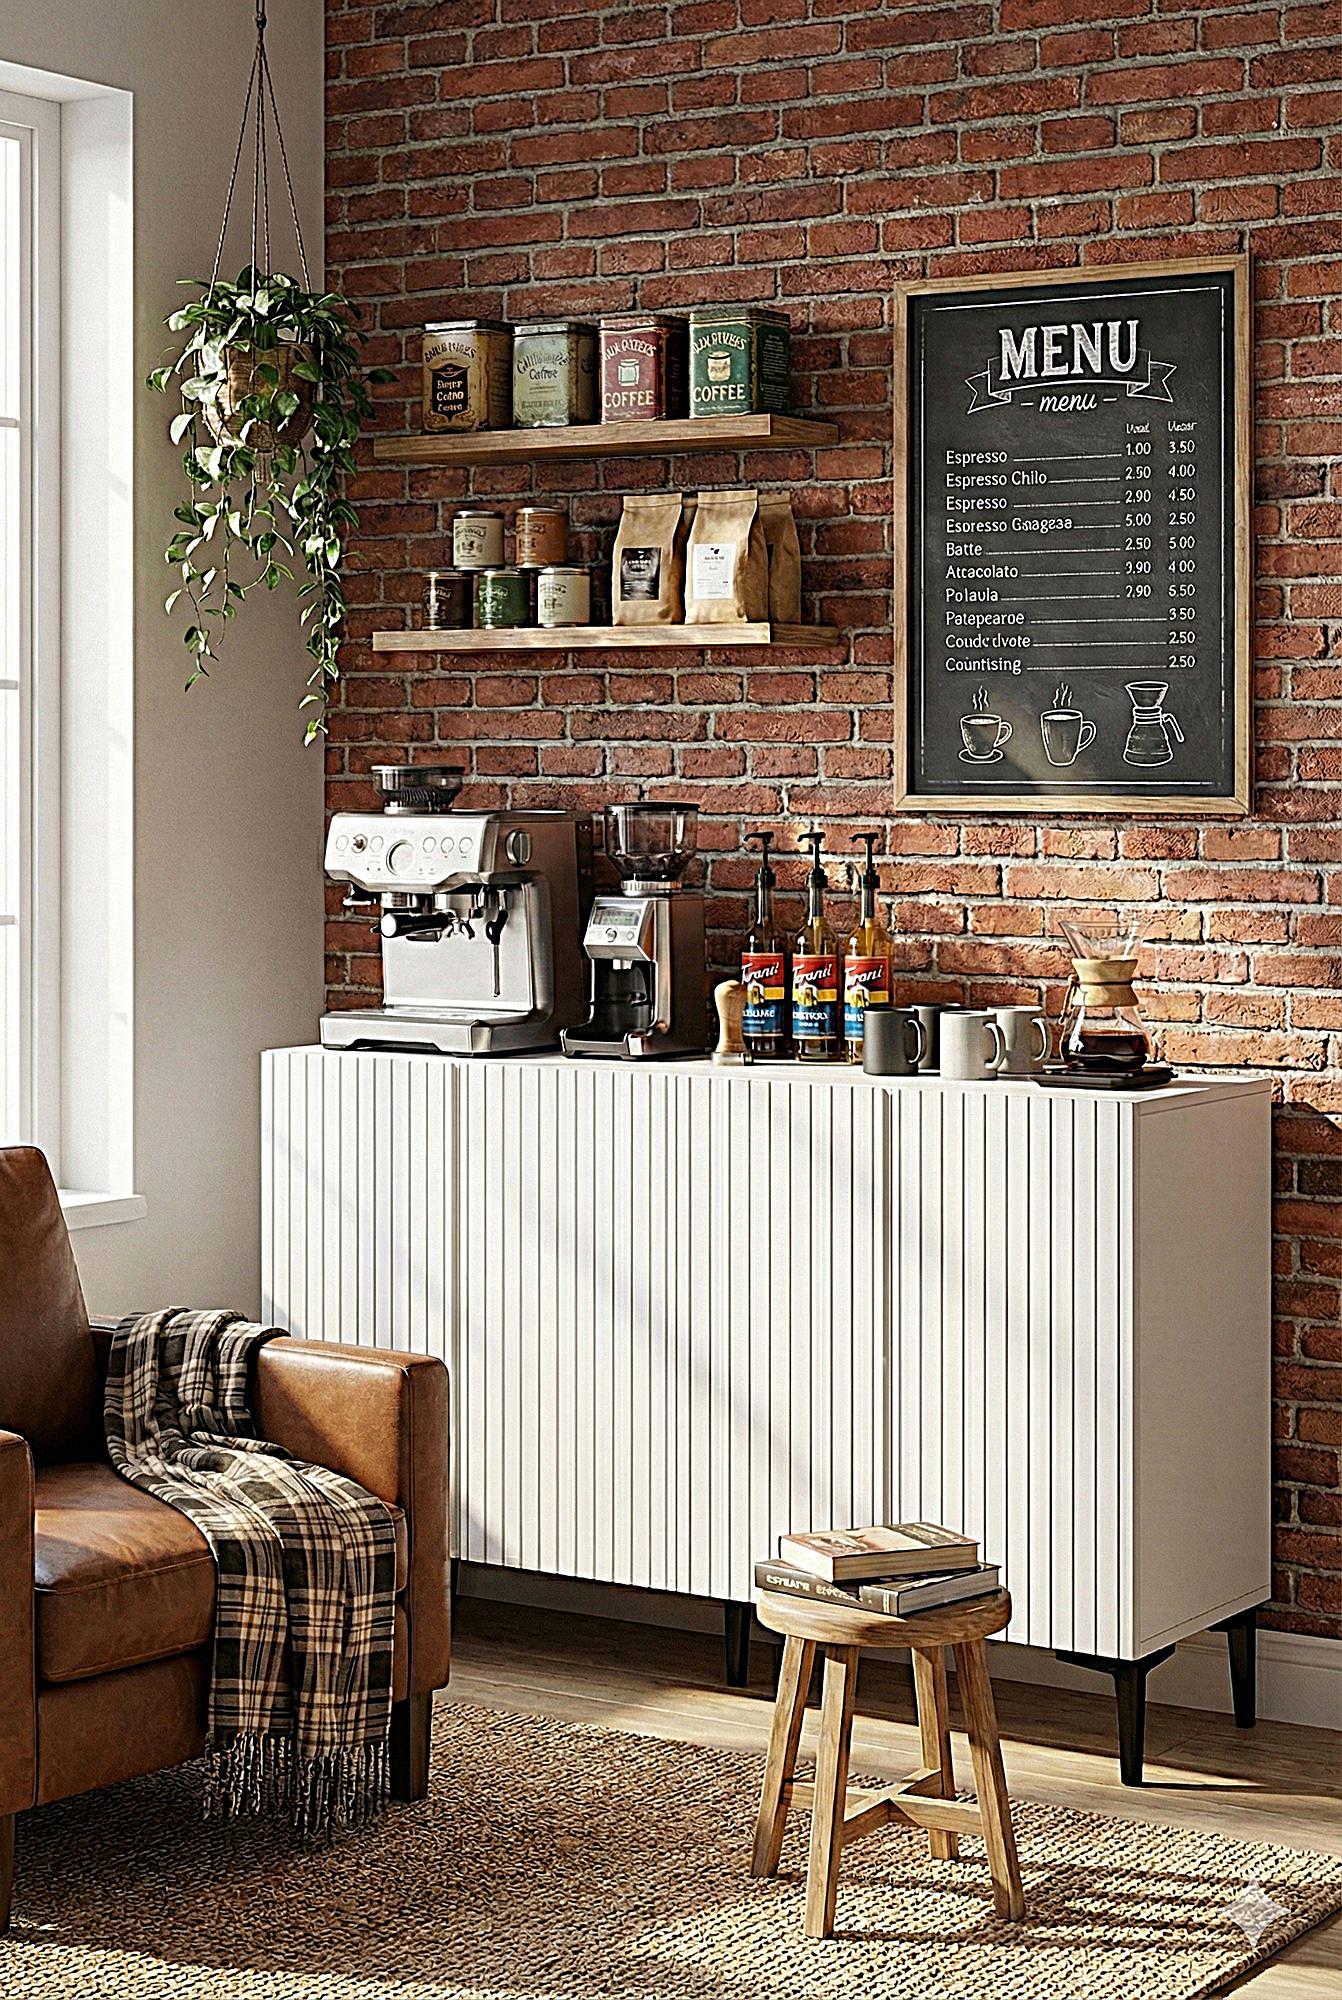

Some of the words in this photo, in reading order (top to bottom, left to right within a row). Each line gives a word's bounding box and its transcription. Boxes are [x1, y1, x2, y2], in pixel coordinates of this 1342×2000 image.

[999, 319, 1139, 381] MENU
[605, 390, 655, 408] COFFEE
[693, 384, 745, 402] COFFEE
[1039, 393, 1097, 412] menu
[946, 450, 1008, 467] Espresso
[1125, 442, 1151, 456] 1.00
[1168, 440, 1195, 454] 3.50
[946, 473, 1007, 490] Espresso
[1011, 470, 1047, 485] Chilo
[1168, 464, 1195, 478] 4.00
[946, 496, 1007, 513] Espresso
[1125, 489, 1151, 504] 2.90
[1168, 488, 1195, 502] 4.50
[1125, 513, 1151, 527] 5.00
[1168, 512, 1195, 526] 2.50
[946, 542, 983, 556] Batte
[1125, 537, 1151, 551] 2.50
[1168, 631, 1195, 645] 2.50
[1168, 655, 1195, 668] 2.50
